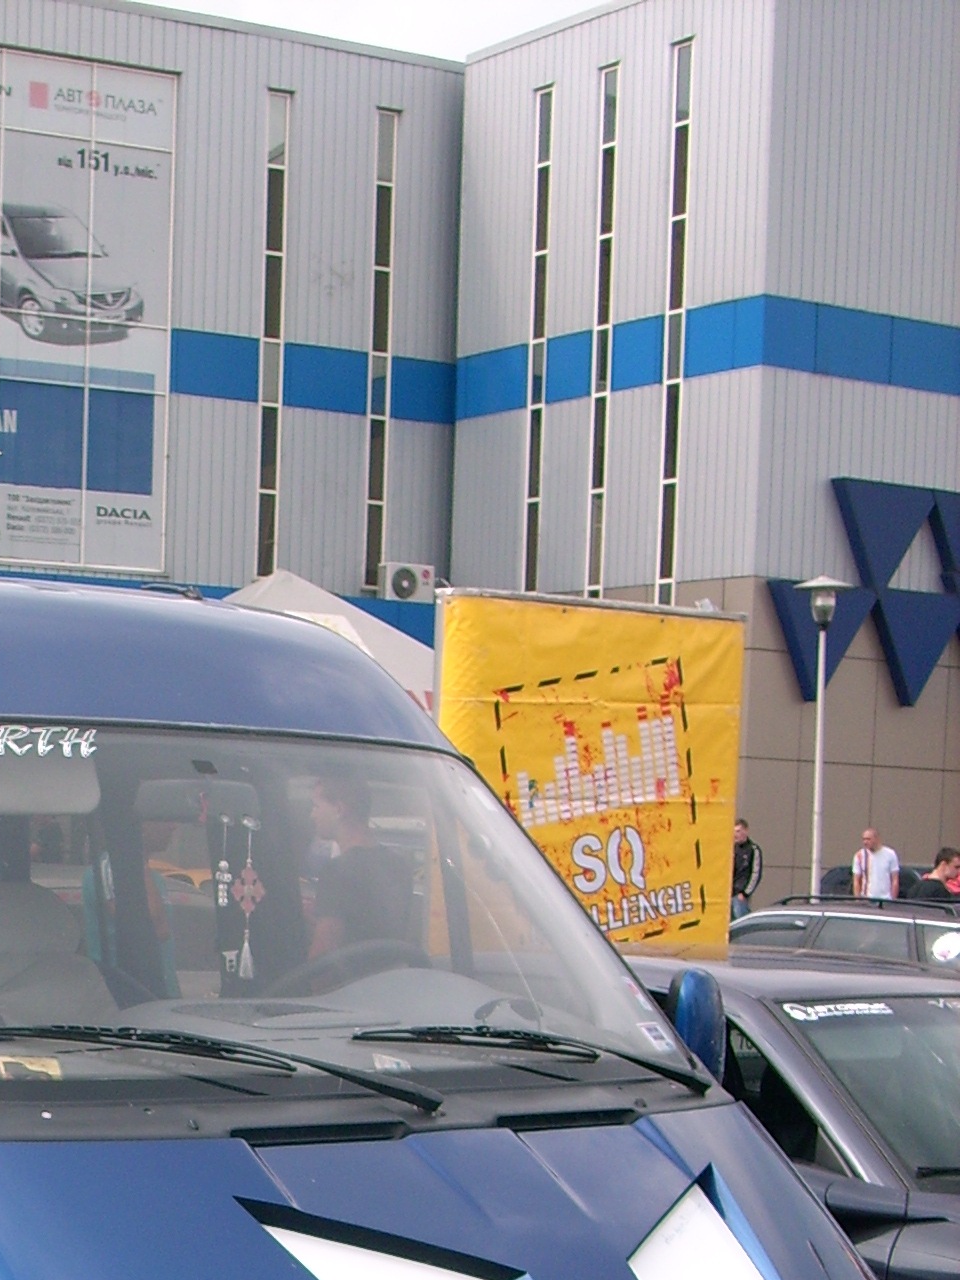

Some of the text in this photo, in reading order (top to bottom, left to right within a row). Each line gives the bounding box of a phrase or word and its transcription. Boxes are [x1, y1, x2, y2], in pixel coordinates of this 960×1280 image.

[77, 147, 110, 173] 151
[96, 505, 152, 521] DACIA
[572, 825, 647, 894] SQ
